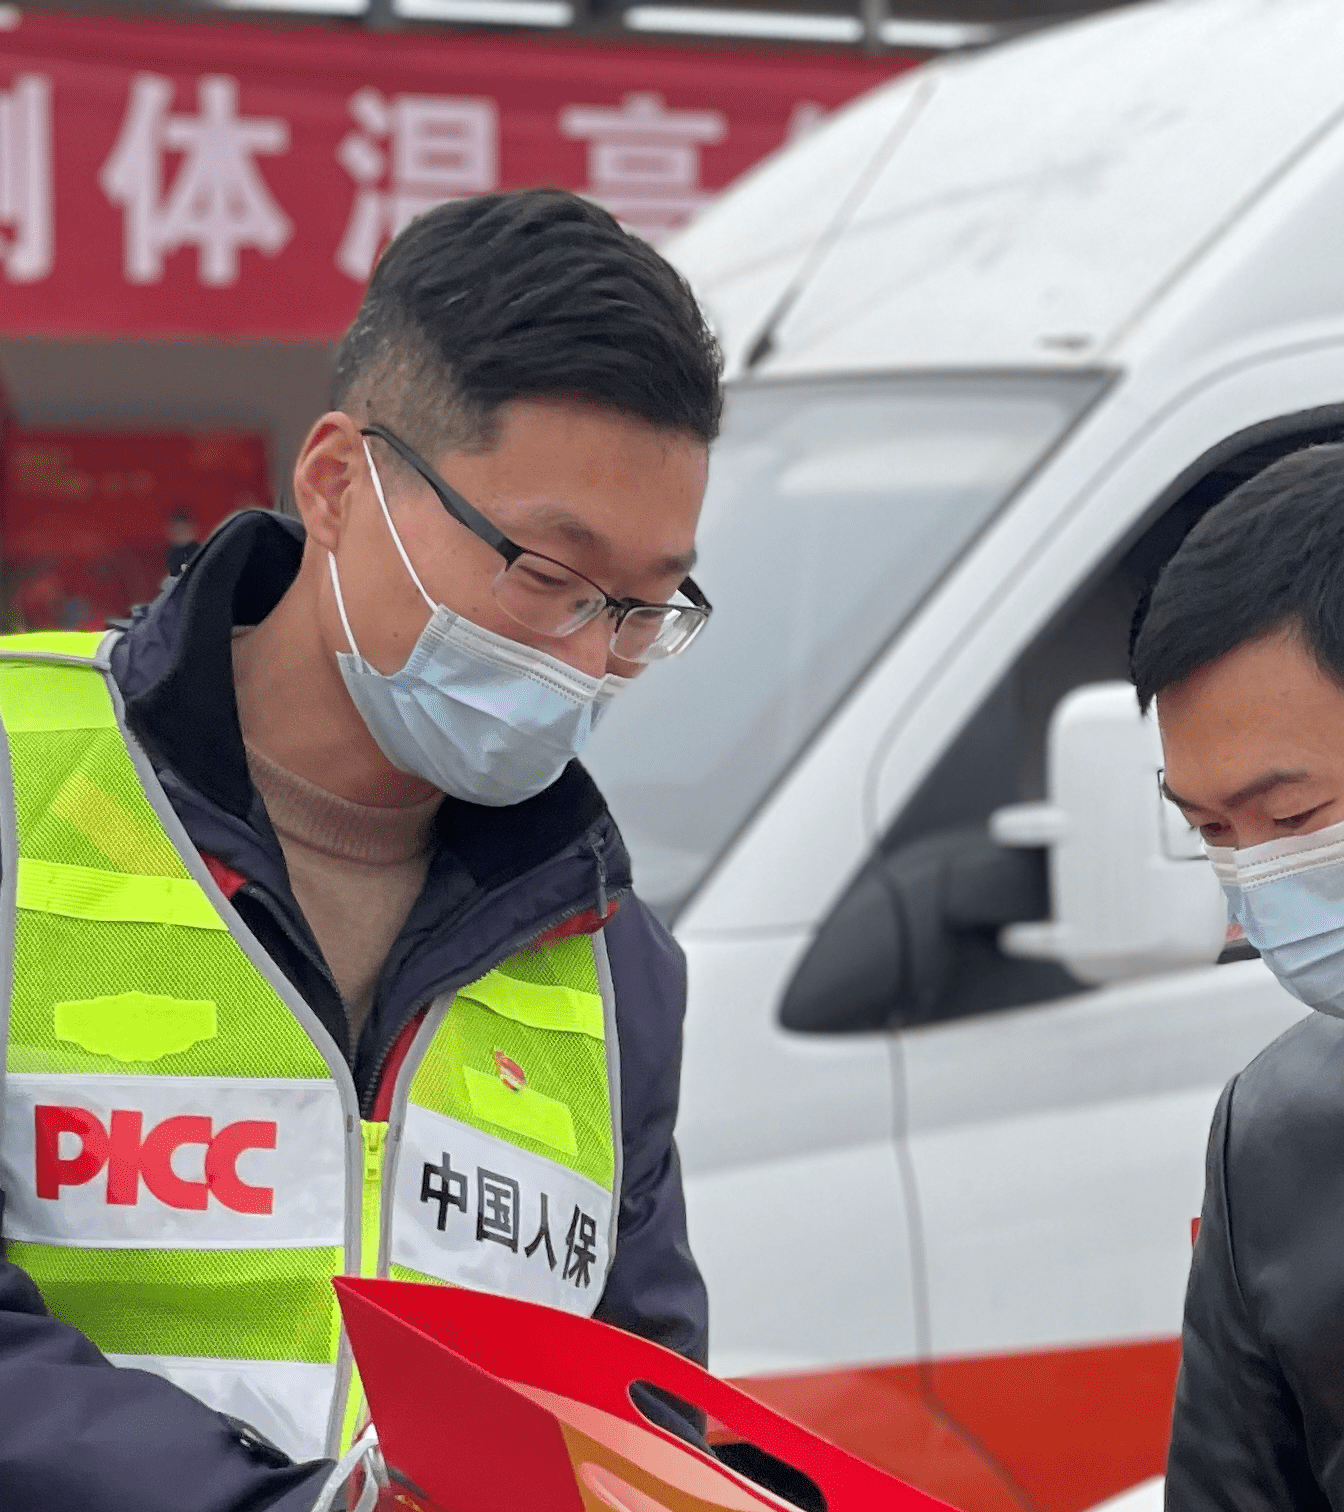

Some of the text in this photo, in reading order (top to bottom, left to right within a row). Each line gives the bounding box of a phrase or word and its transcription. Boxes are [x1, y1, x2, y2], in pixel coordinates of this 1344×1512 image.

[34, 1103, 278, 1215] PICC
[420, 1152, 598, 1288] 中国人保
